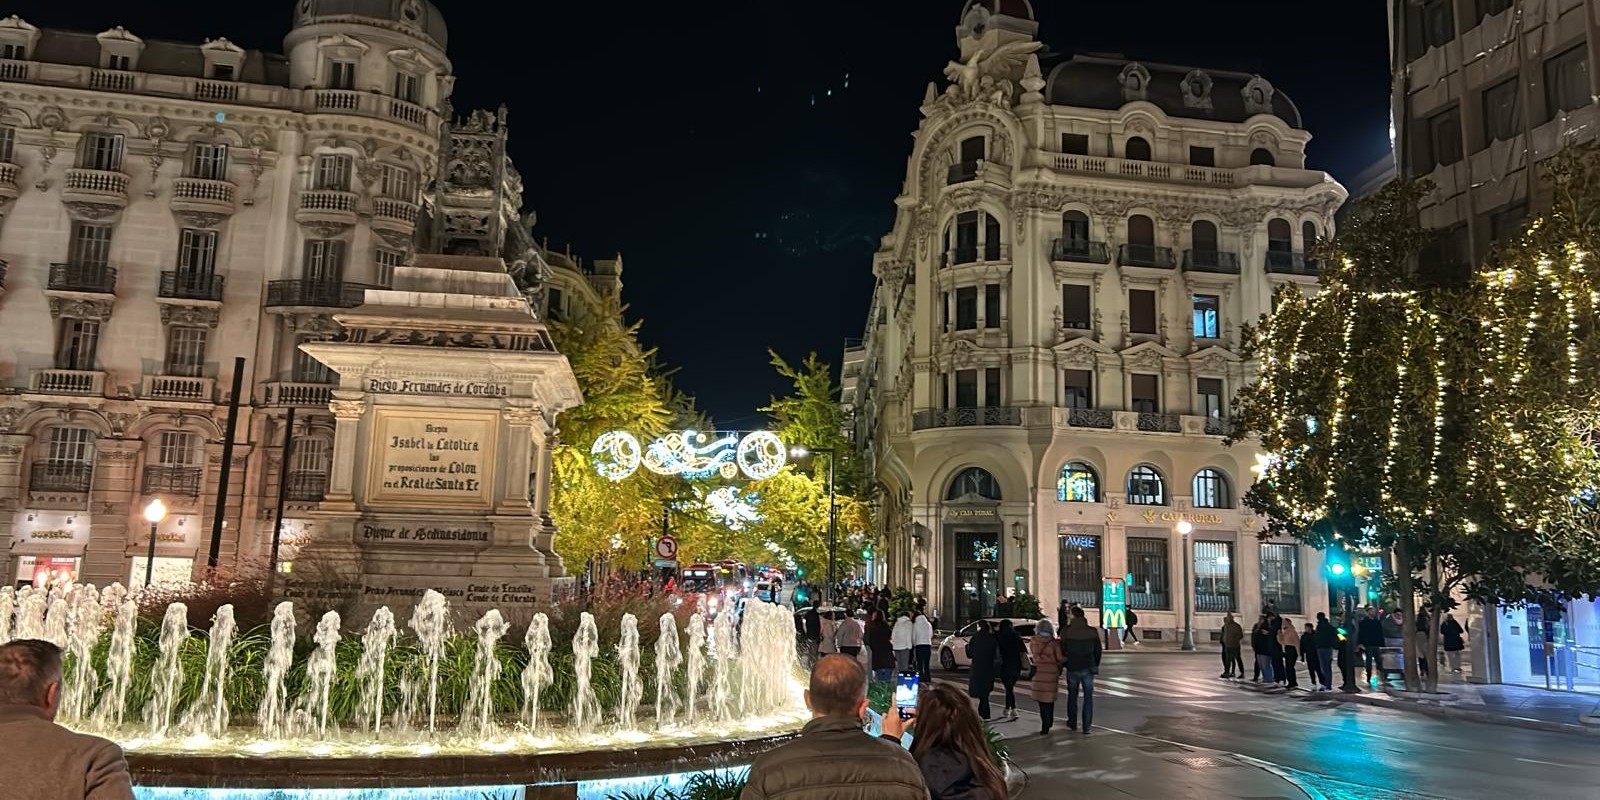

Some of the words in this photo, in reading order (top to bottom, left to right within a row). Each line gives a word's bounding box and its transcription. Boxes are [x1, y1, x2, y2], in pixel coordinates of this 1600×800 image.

[370, 379, 397, 392] Diego
[453, 383, 464, 393] de
[466, 382, 507, 395] Cordoba
[390, 436, 425, 449] Isabel
[427, 441, 434, 449] la
[436, 438, 479, 451] Catolica
[429, 453, 440, 461] las
[389, 465, 437, 474] proposiciones
[439, 465, 447, 473] de
[448, 461, 477, 474] Colon
[400, 476, 424, 489] Real
[435, 478, 464, 490] Santa
[466, 479, 479, 491] Fe
[1188, 512, 1223, 524] RURAL
[363, 525, 395, 540] Duque
[399, 527, 410, 539] de
